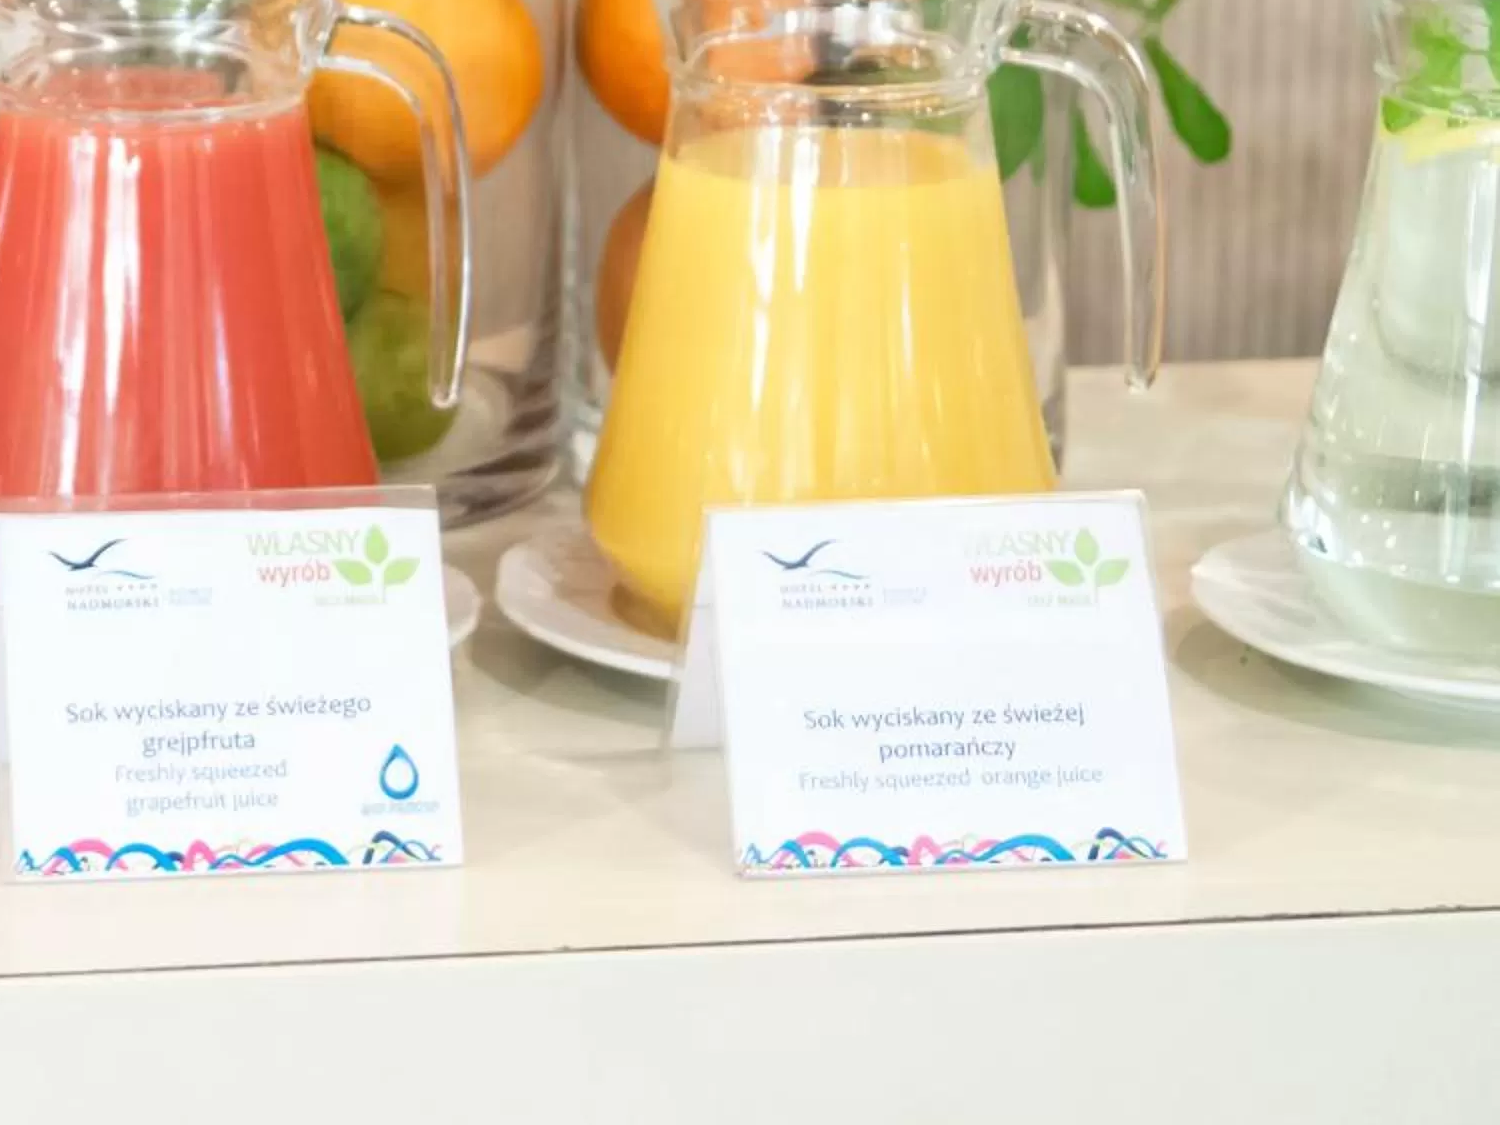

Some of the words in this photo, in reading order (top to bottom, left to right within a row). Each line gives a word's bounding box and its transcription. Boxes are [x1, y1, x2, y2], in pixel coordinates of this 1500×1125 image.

[256, 557, 331, 588] wyrób
[969, 558, 1042, 588] wyrób
[65, 702, 108, 724] Sok
[114, 699, 228, 726] wyciskany
[234, 700, 261, 716] ze
[266, 693, 372, 718] świeżego
[803, 708, 845, 730] Sok
[851, 706, 965, 732] wyciskany
[972, 708, 997, 725] ze
[1002, 703, 1085, 726] świeżej
[142, 730, 256, 758] grejpfruta
[879, 736, 1017, 763] pomarańczy
[114, 762, 187, 785] Freshly
[191, 759, 288, 784] squeezed
[799, 771, 869, 793] Freshly
[875, 768, 971, 791] squeezed
[981, 770, 1052, 789] orange
[1057, 765, 1103, 788] juice
[126, 791, 226, 817] grapefruit
[233, 790, 279, 812] juice
